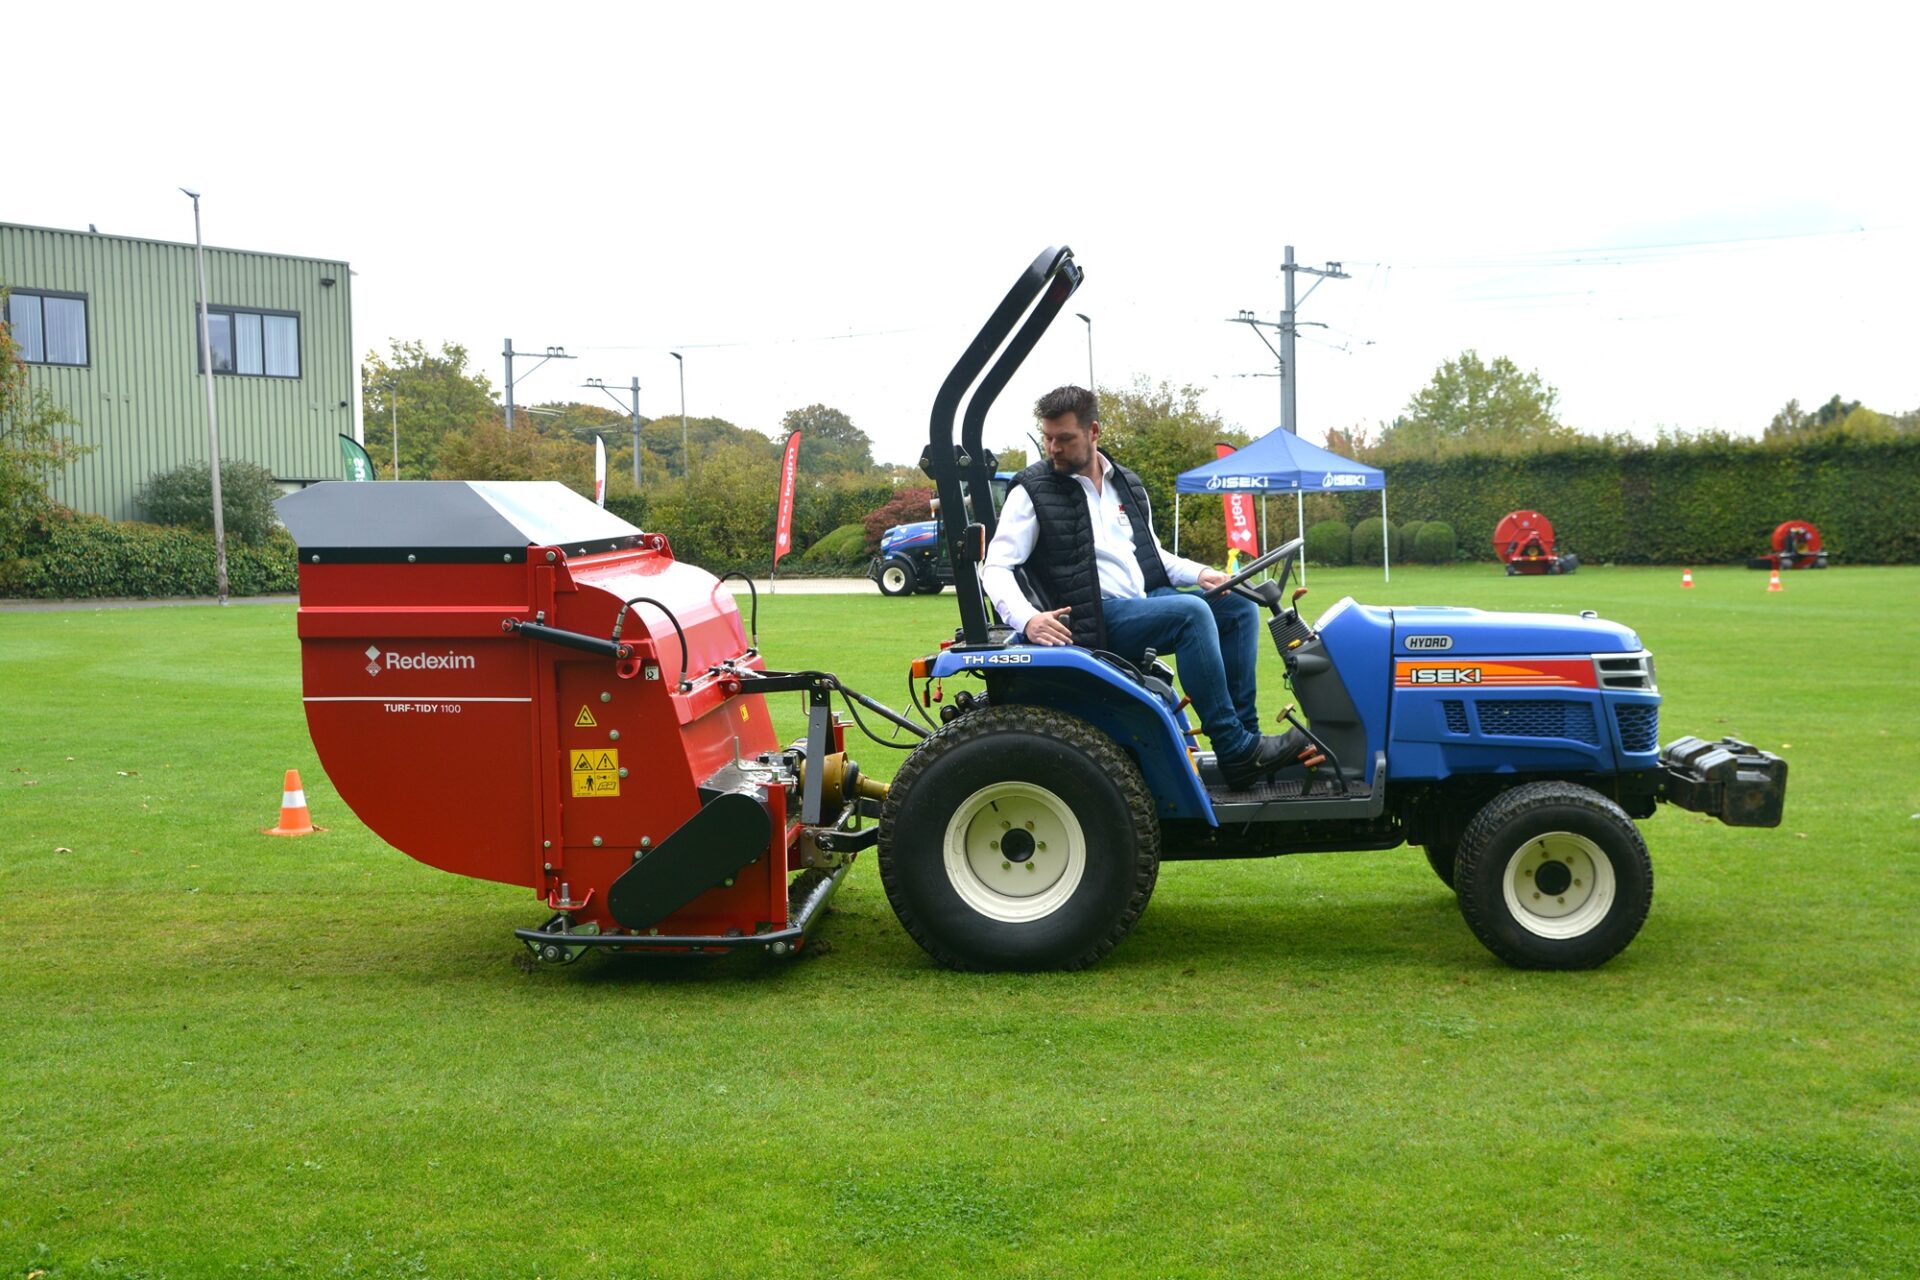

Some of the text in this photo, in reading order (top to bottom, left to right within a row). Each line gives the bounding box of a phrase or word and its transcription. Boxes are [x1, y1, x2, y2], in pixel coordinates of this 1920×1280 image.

[1222, 476, 1269, 489] ISEKI
[1333, 475, 1366, 486] ISEKI
[1409, 637, 1448, 648] HYDRO
[385, 650, 476, 669] Redexim
[962, 654, 1031, 664] TH 4330
[1411, 669, 1480, 683] ISEKI
[384, 703, 461, 713] TURF-TIDY 1100
